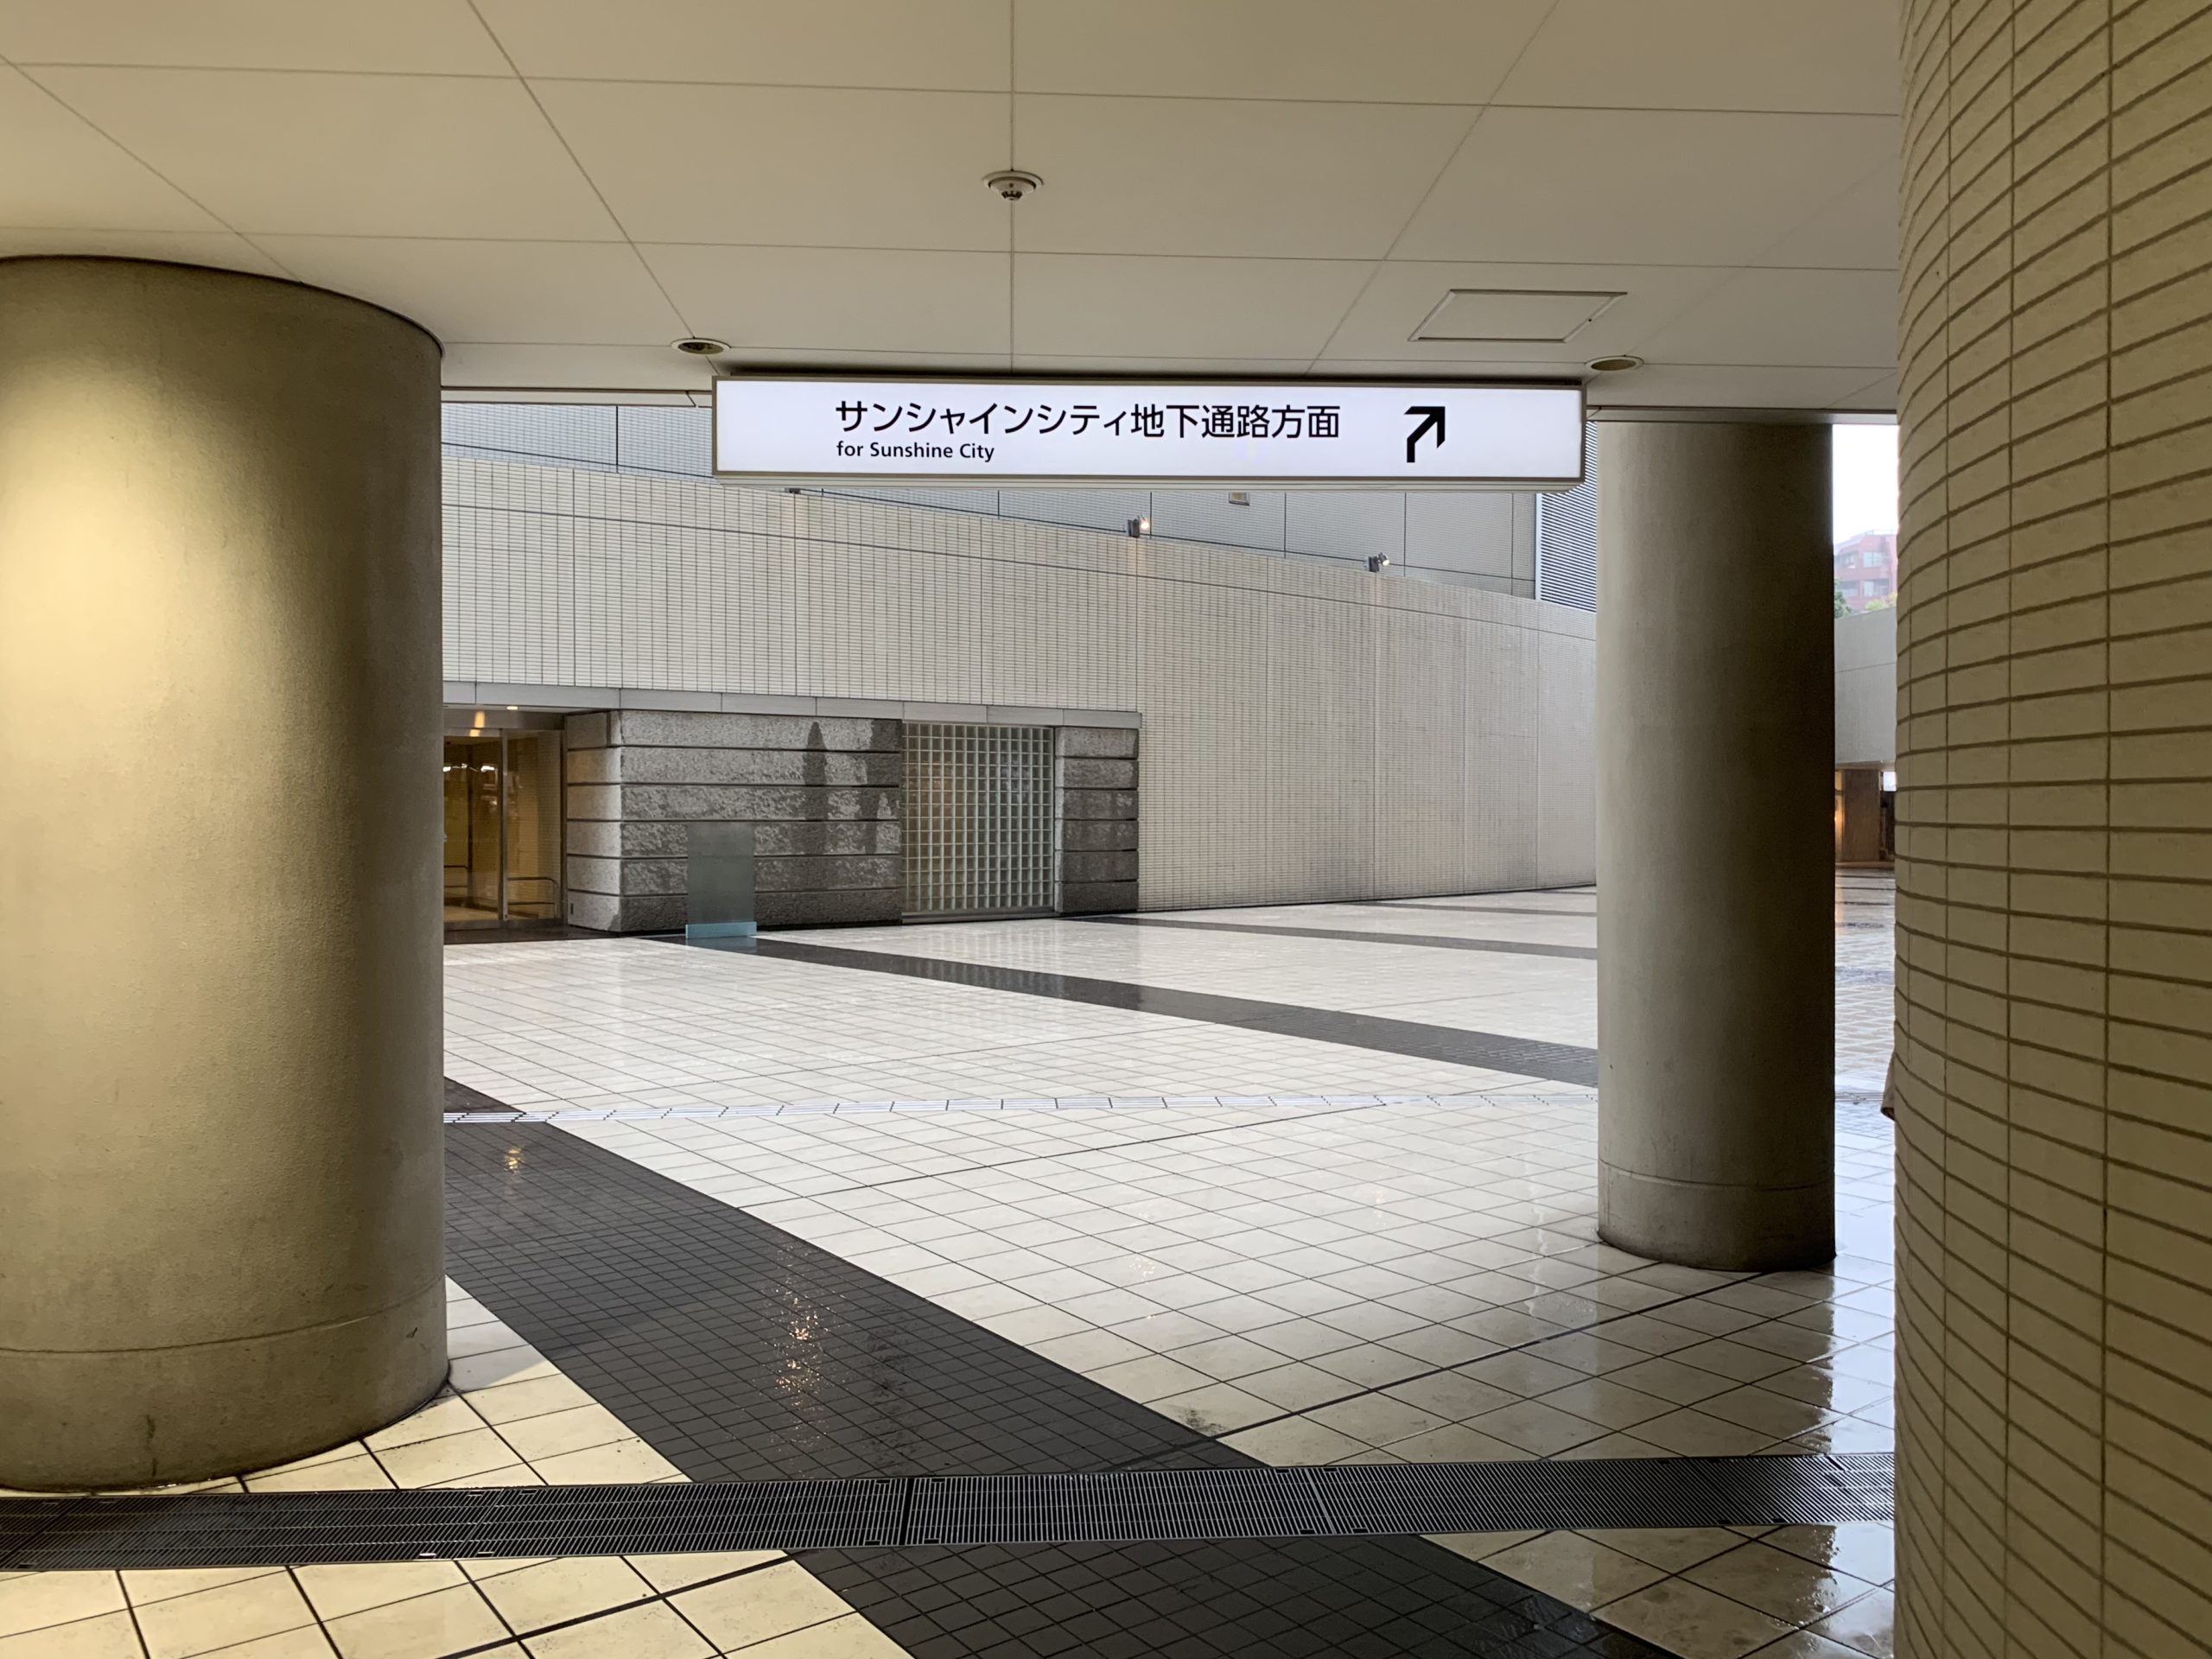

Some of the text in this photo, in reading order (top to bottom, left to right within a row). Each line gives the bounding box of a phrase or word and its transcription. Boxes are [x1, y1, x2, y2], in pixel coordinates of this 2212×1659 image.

[836, 400, 1341, 439] サンシャインシティ地下通路方面
[836, 441, 995, 463] for Sunshine City
